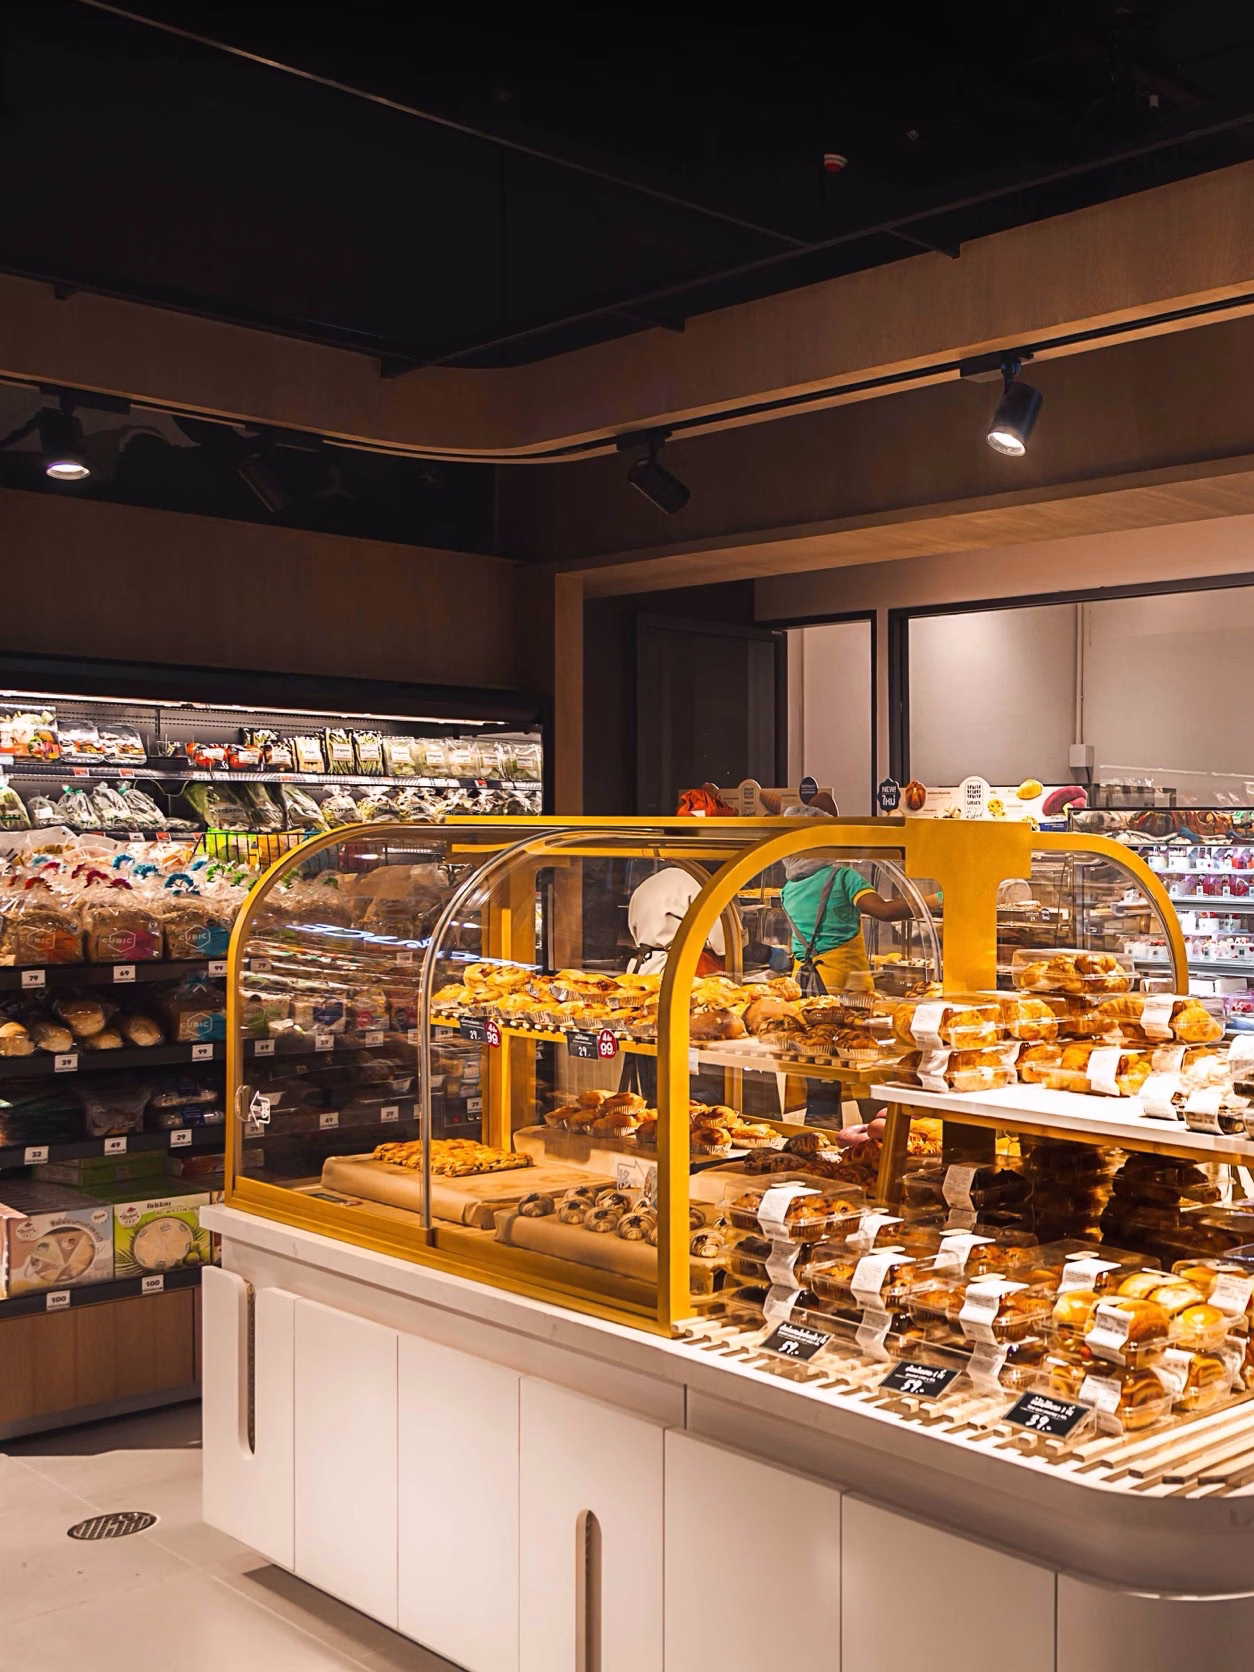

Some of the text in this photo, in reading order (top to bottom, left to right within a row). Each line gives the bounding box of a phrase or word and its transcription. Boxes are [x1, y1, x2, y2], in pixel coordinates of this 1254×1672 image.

[881, 785, 897, 793] NEW!
[101, 936, 133, 945] CUBIC
[178, 932, 207, 942] CUBIC
[28, 974, 39, 982] 79
[180, 1020, 210, 1030] CUBIC
[176, 1133, 187, 1141] 29
[110, 1141, 121, 1149] 49
[145, 1279, 161, 1288] 100
[51, 1295, 67, 1304] 100
